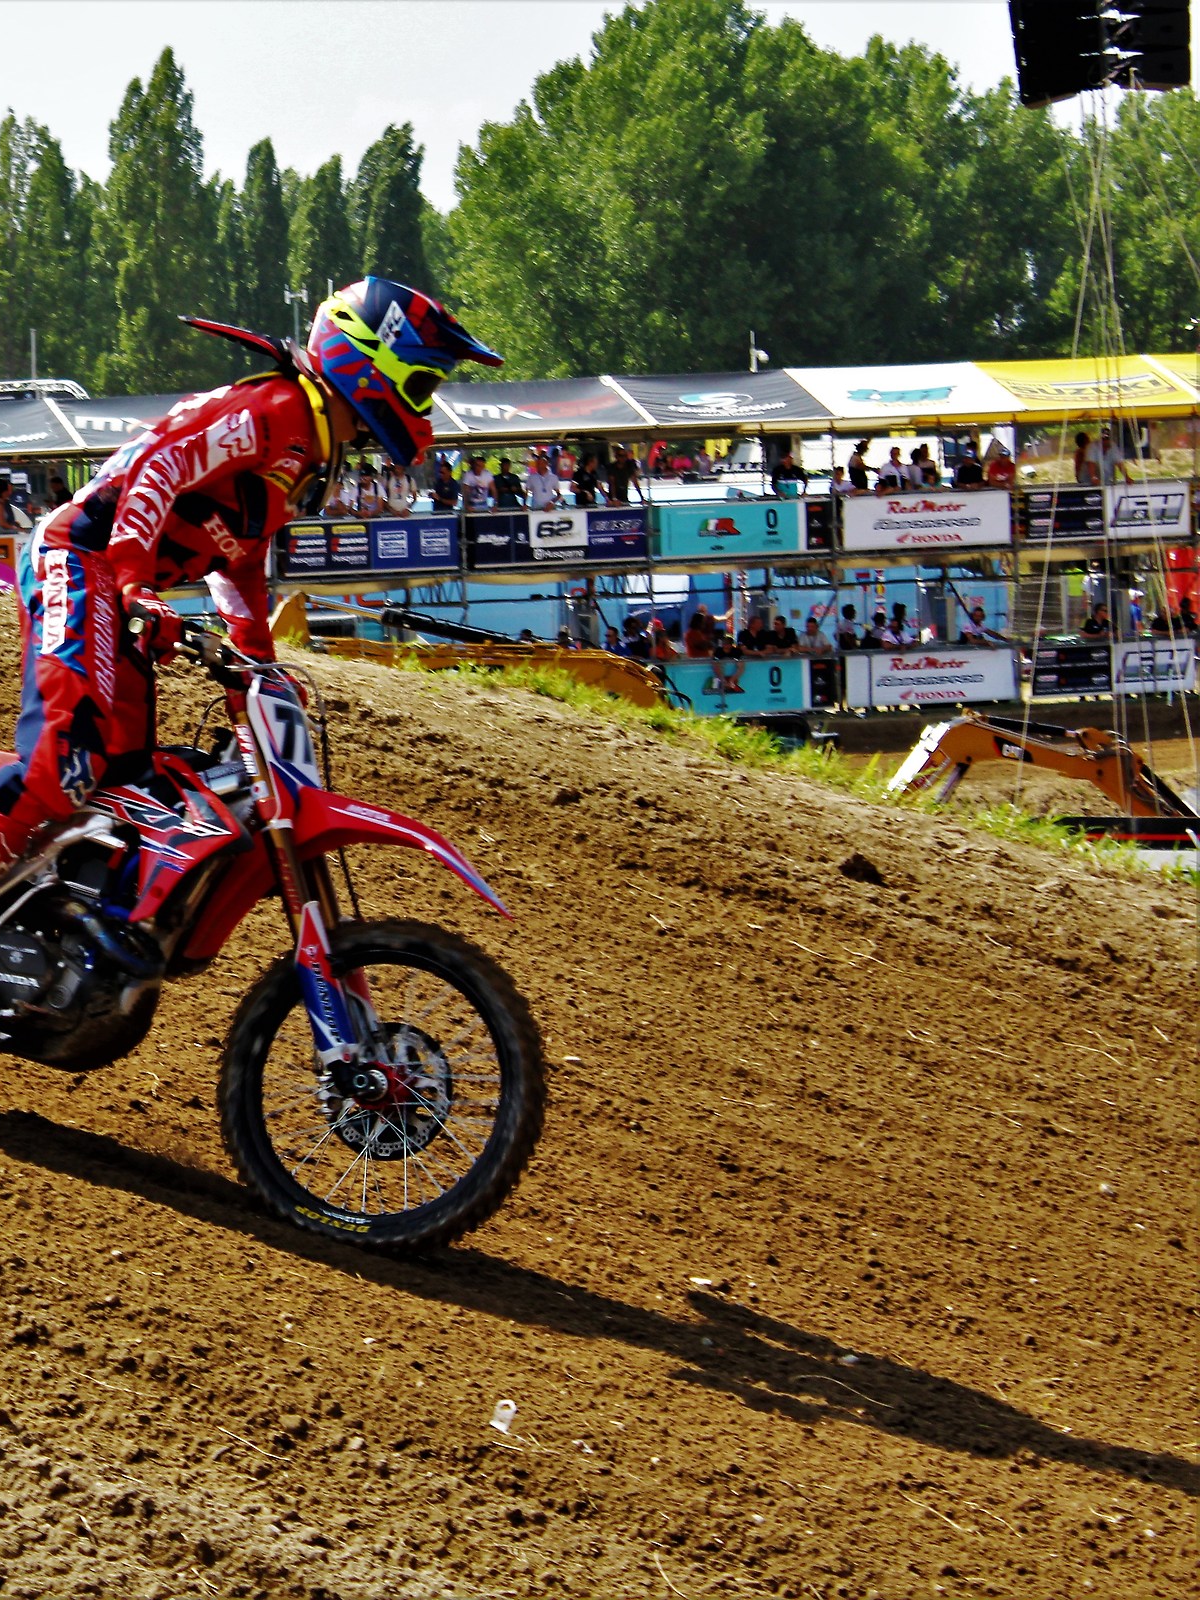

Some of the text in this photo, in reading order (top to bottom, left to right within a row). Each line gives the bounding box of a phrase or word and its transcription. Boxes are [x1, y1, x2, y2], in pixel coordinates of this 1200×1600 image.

[537, 519, 573, 540] 62
[911, 533, 963, 543] HONDA
[914, 690, 967, 700] HONDA
